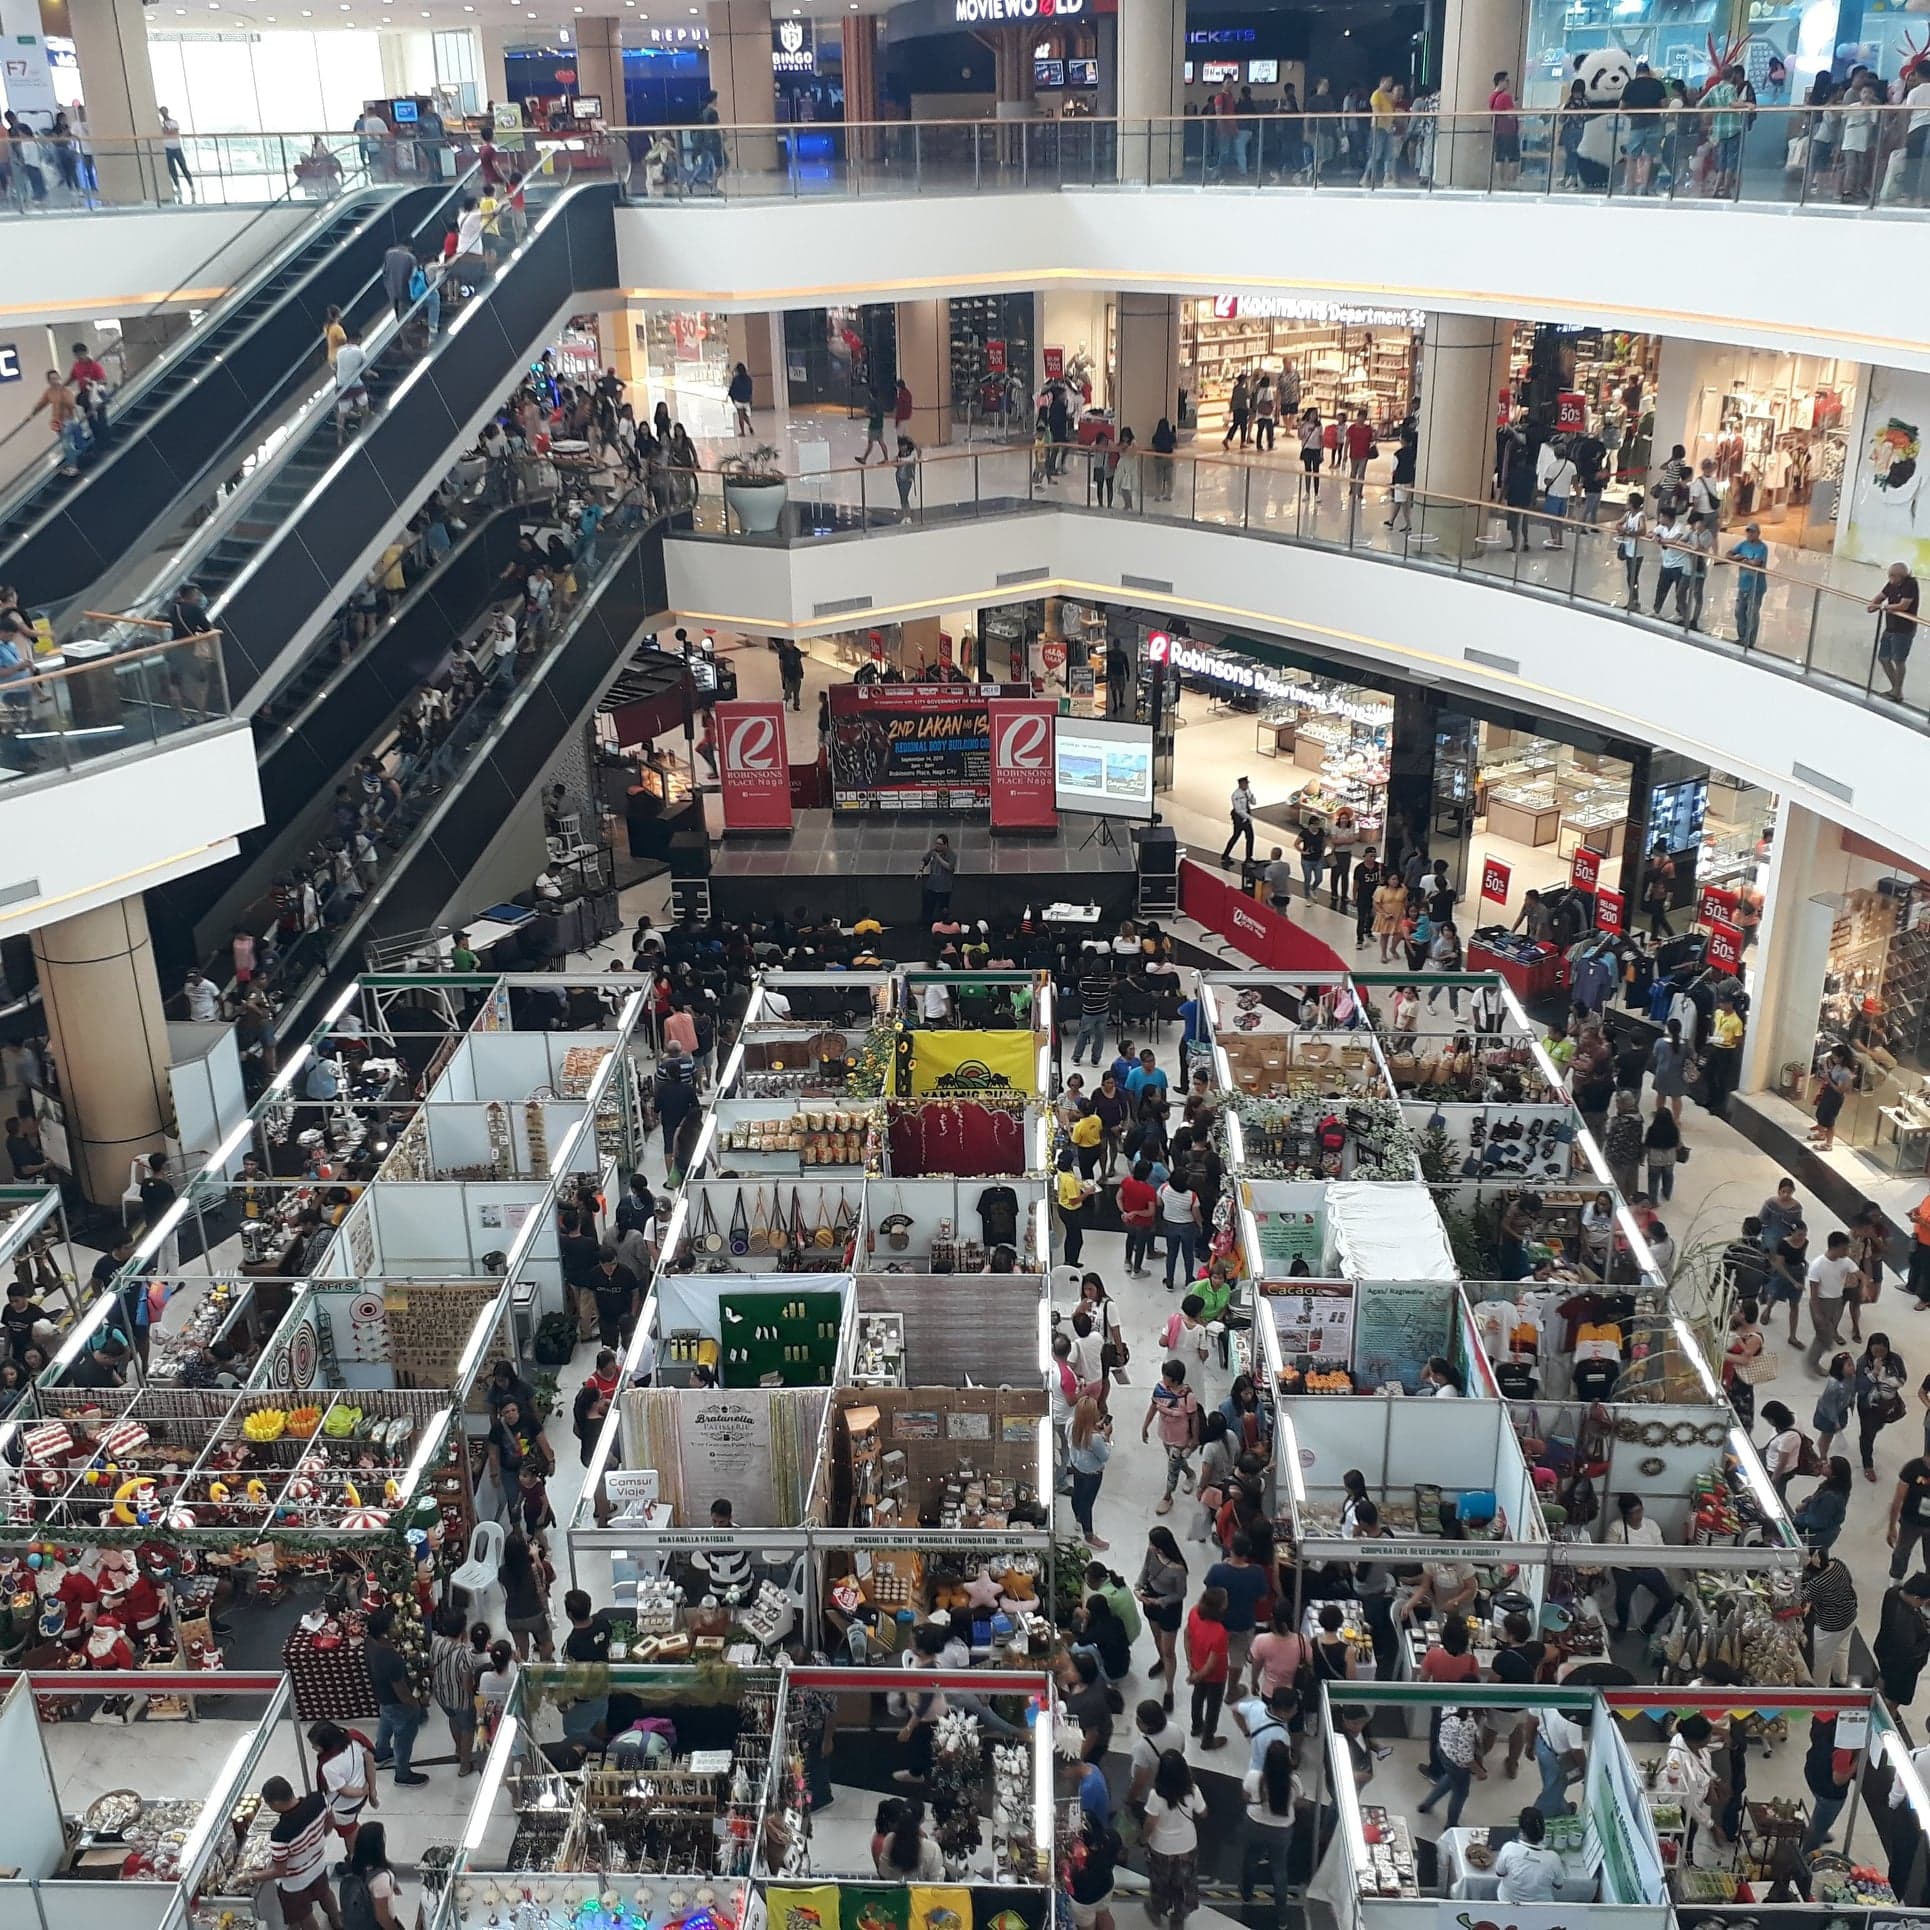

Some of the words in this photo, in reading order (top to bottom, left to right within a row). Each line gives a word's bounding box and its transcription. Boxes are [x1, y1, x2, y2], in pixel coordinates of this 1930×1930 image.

[772, 51, 812, 64] BINGO
[1329, 302, 1408, 326] Department
[1170, 641, 1254, 687] Robinsons
[1254, 672, 1328, 709] Department
[1330, 694, 1366, 719] Store
[888, 719, 914, 740] 2ND
[917, 715, 963, 738] LAKAN
[895, 741, 928, 753] REGIONAL
[929, 740, 947, 751] BODY
[949, 739, 979, 750] BUILDING
[727, 771, 783, 779] ROBINSONS
[946, 768, 957, 776] City
[996, 769, 1052, 777] ROBINSONS
[758, 779, 783, 787] Naga
[1026, 777, 1052, 786] Naga
[1267, 1284, 1316, 1297] Cacao
[695, 1413, 755, 1425] Bratanella
[608, 1478, 653, 1487] Camsur
[616, 1487, 646, 1497] Viaje
[658, 1535, 700, 1544] BRATANELLA
[854, 1536, 889, 1544] CONSUELO
[917, 1536, 953, 1545] MADRIGAL
[954, 1536, 998, 1545] FOUNDATION
[1004, 1537, 1024, 1545] BICOL
[1360, 1546, 1408, 1555] COOPERATIVE
[1408, 1547, 1460, 1556] DEVELOPMENT
[1461, 1547, 1502, 1556] AUTHORITY
